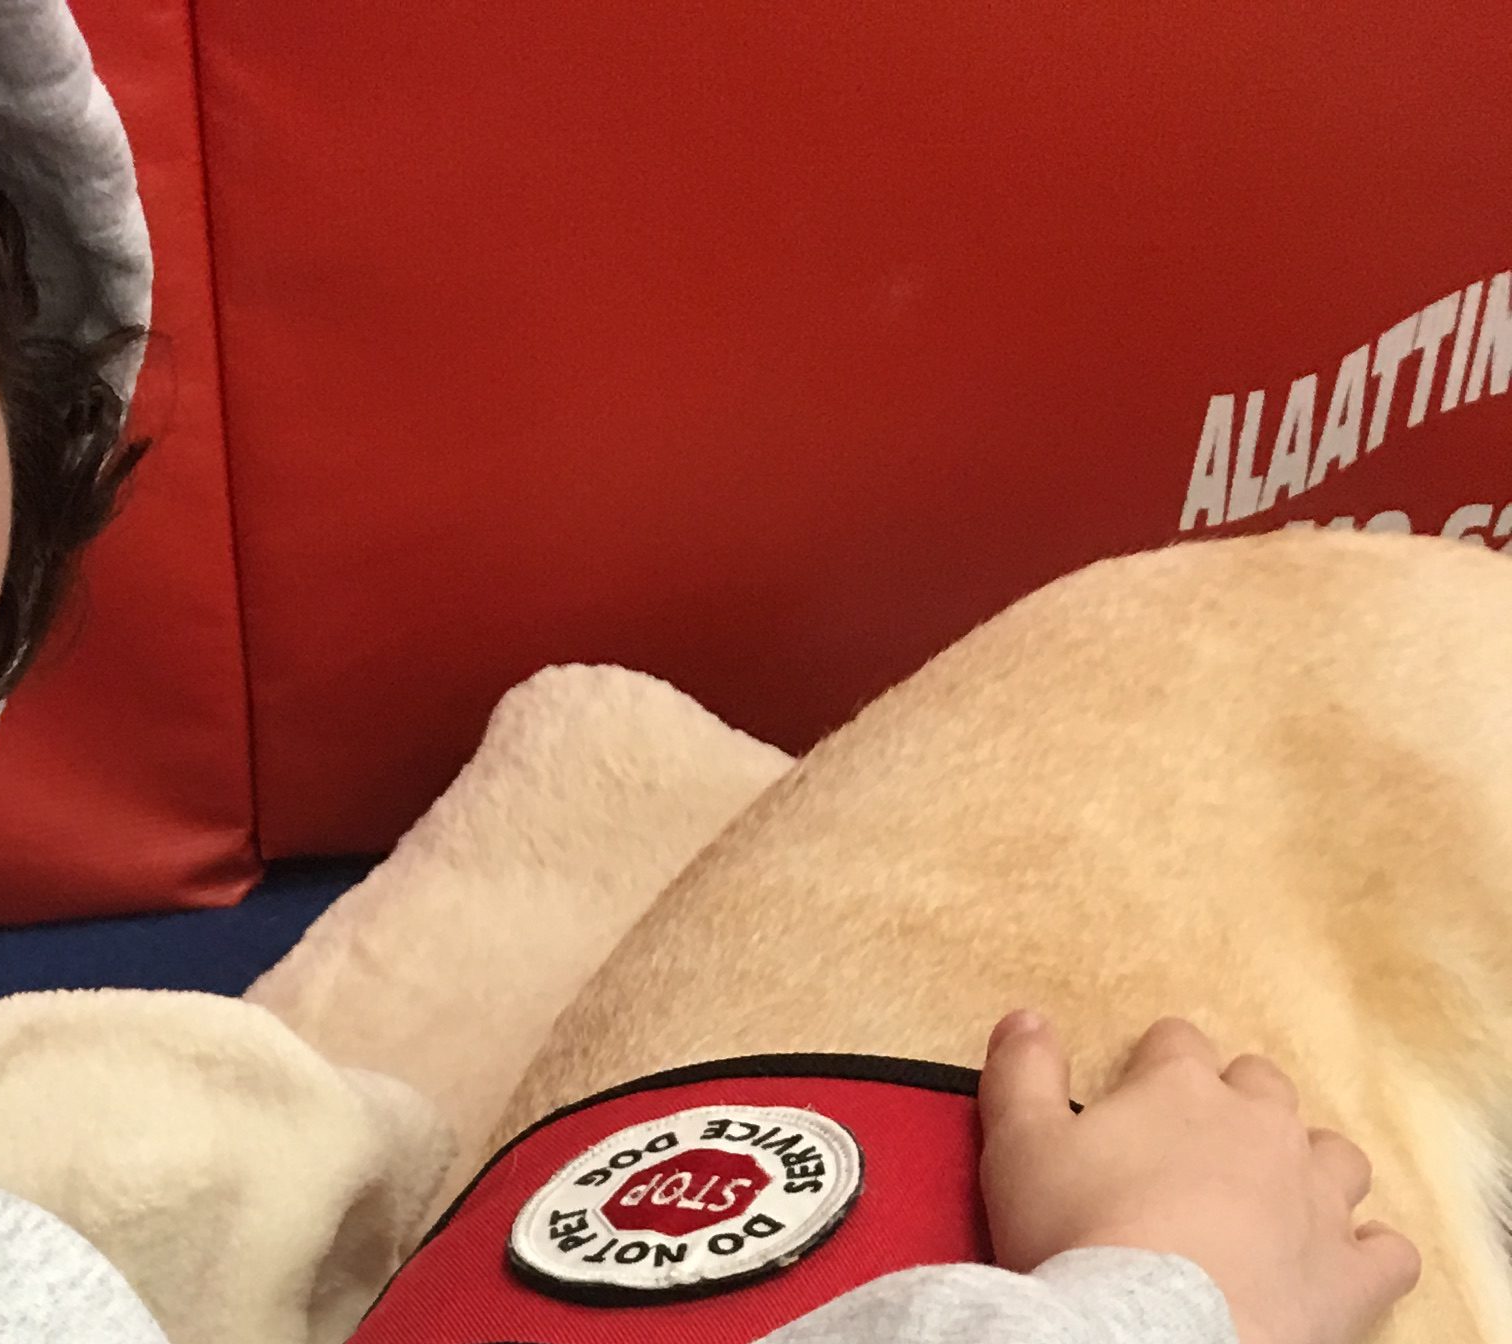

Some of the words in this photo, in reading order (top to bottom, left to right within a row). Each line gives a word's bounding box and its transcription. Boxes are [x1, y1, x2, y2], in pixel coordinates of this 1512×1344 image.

[573, 1132, 679, 1188] DOG
[700, 1119, 826, 1194] SERVICE
[619, 1170, 753, 1212] STOP
[549, 1207, 598, 1254] PET
[583, 1238, 688, 1268] NOT
[707, 1213, 786, 1256] DO
